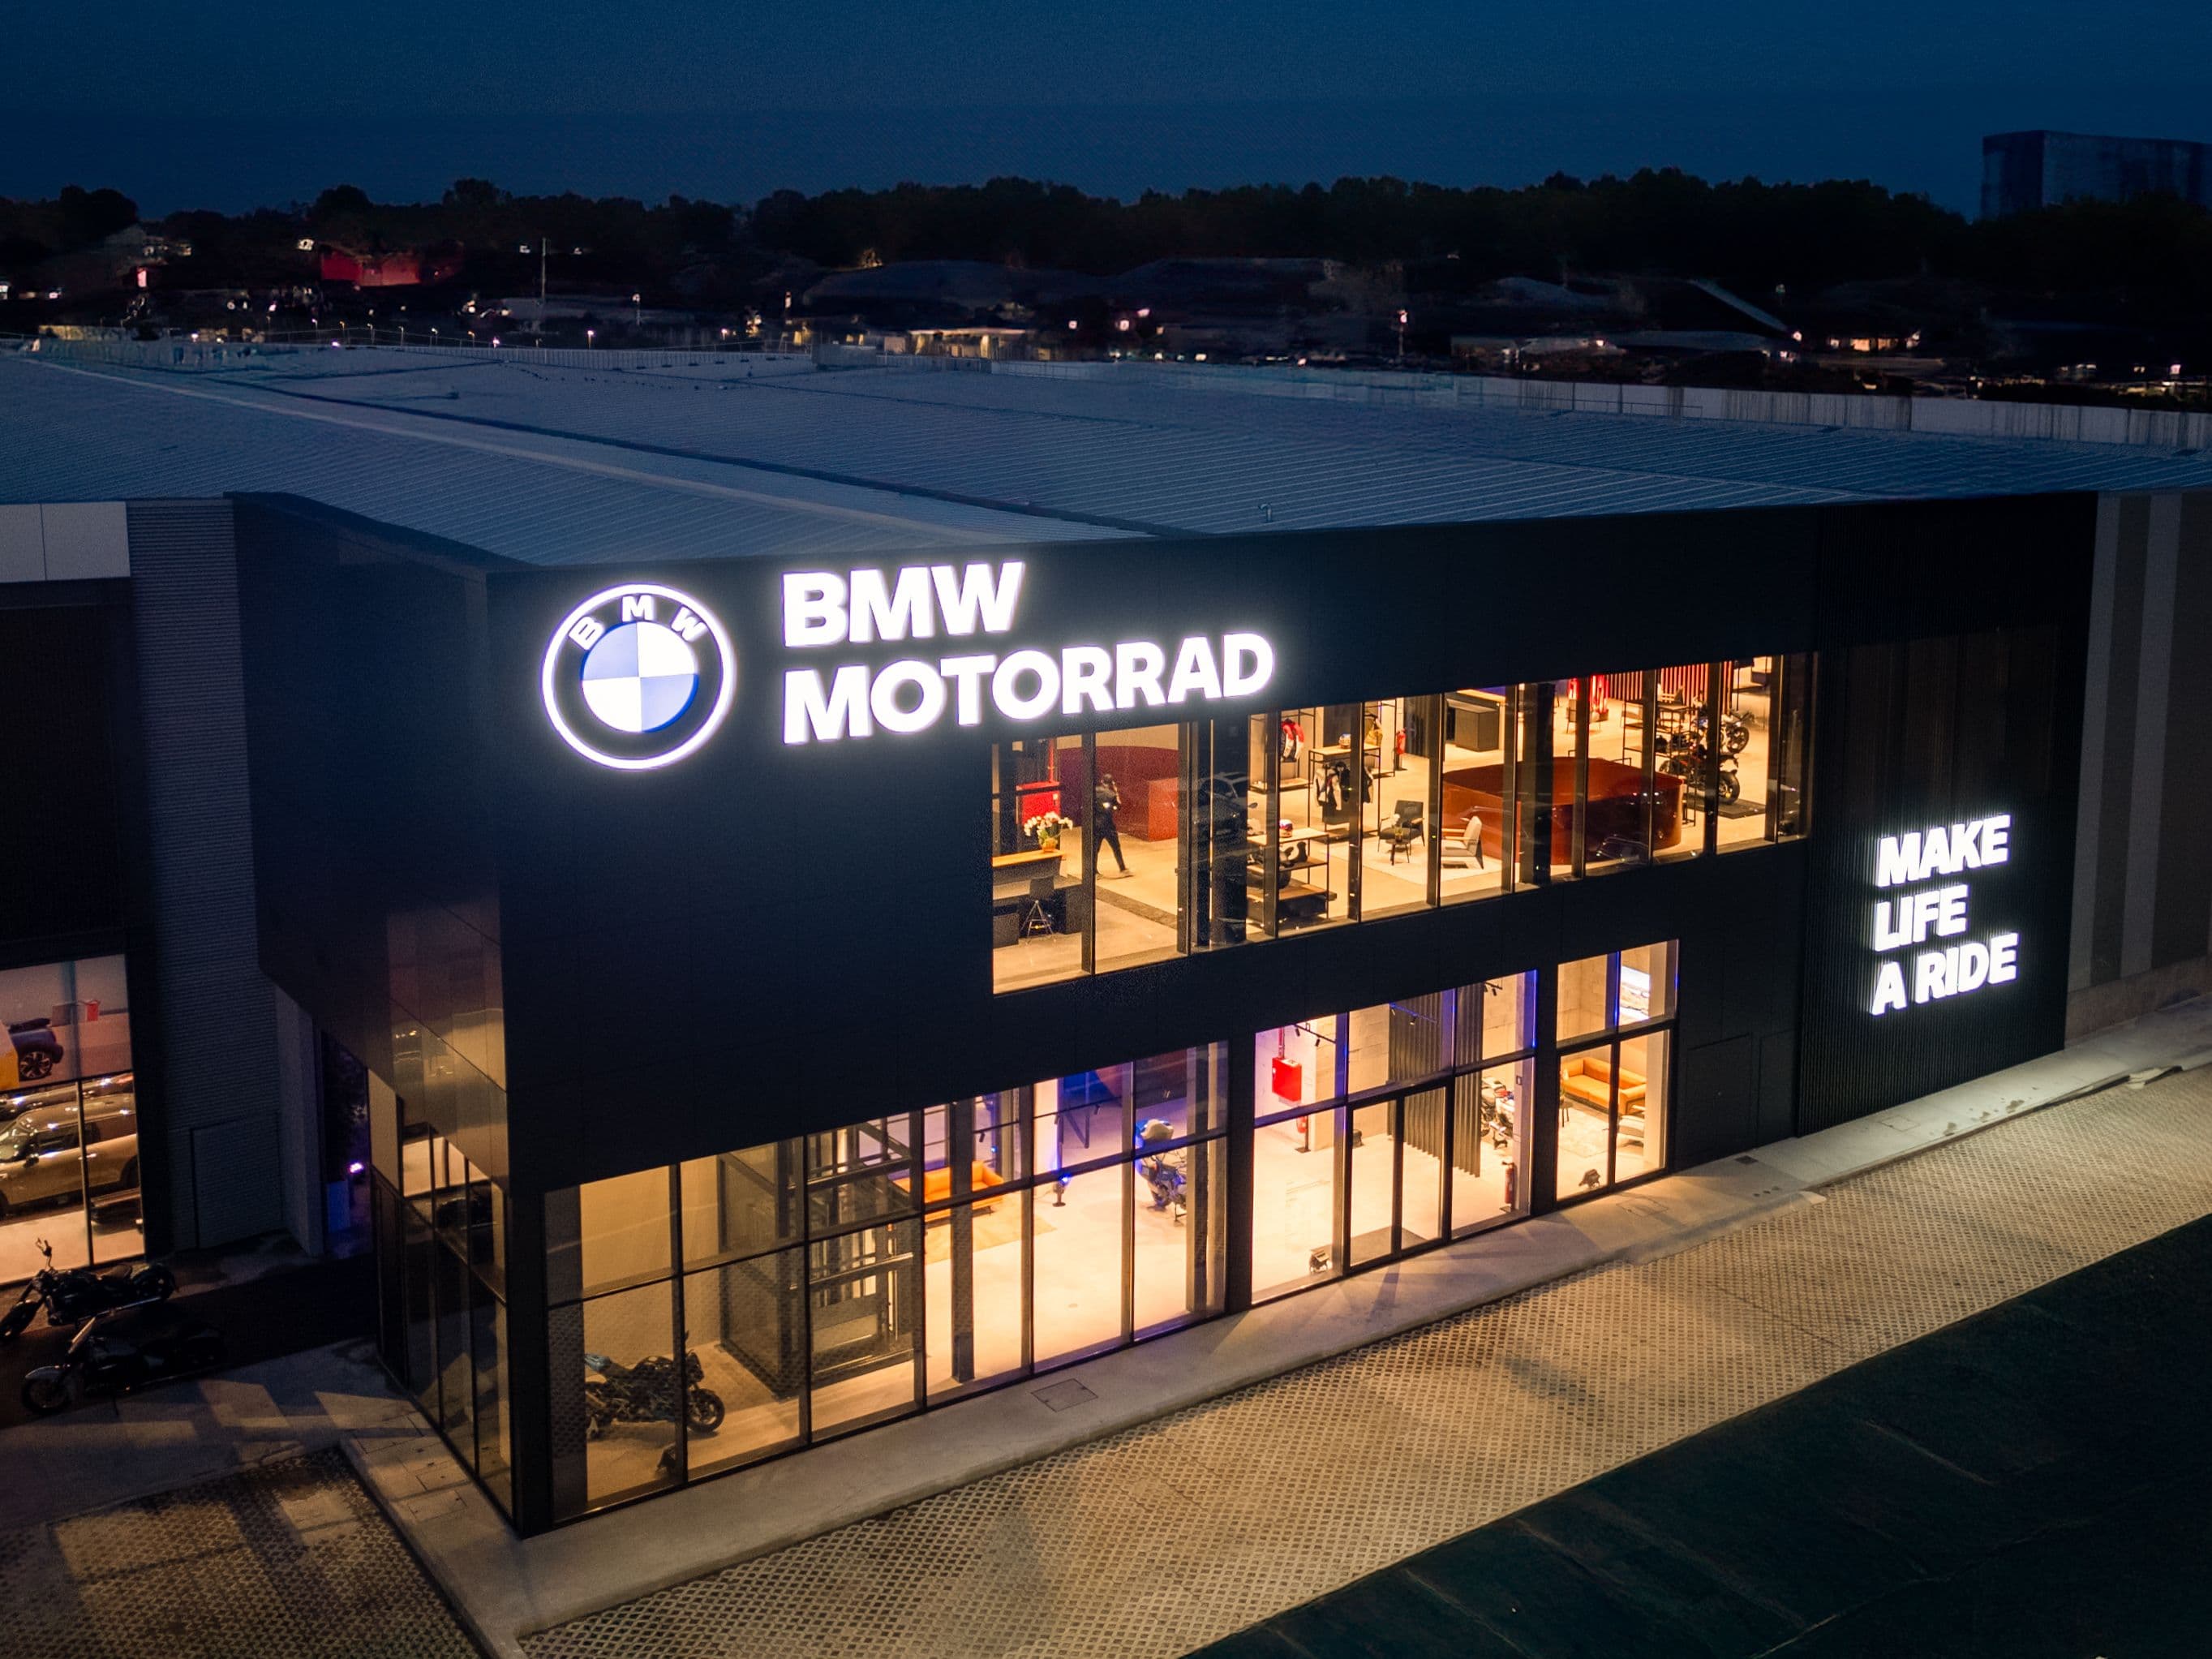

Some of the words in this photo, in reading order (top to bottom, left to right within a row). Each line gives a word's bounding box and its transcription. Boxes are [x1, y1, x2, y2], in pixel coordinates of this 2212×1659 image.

[569, 595, 707, 651] BMW
[782, 561, 1025, 647] BMW
[782, 633, 1275, 745] MOTORRAD
[1876, 814, 2011, 888] MAKE
[1874, 884, 1969, 952] LIFE
[1871, 961, 1907, 1016] A
[1913, 933, 2019, 1004] RIDE
